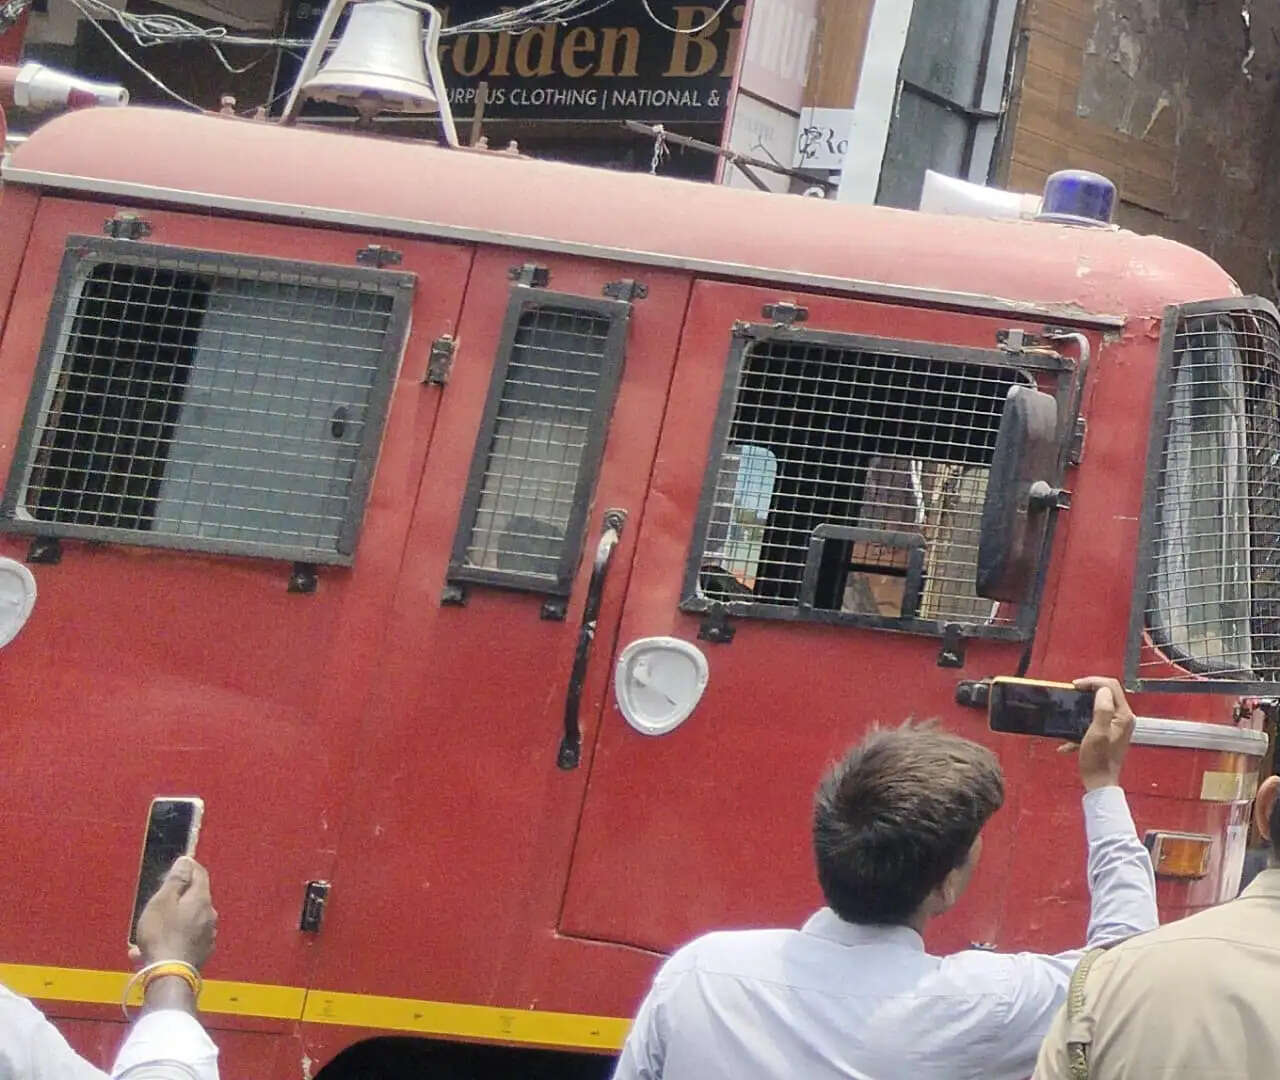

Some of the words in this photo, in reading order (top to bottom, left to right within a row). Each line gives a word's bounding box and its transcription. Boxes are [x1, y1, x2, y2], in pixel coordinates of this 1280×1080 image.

[440, 4, 640, 80] olden
[662, 4, 740, 79] Bi
[447, 88, 505, 107] URPUS
[509, 88, 598, 108] CLOTHING
[612, 90, 702, 108] NATIONAL
[708, 93, 721, 108] &
